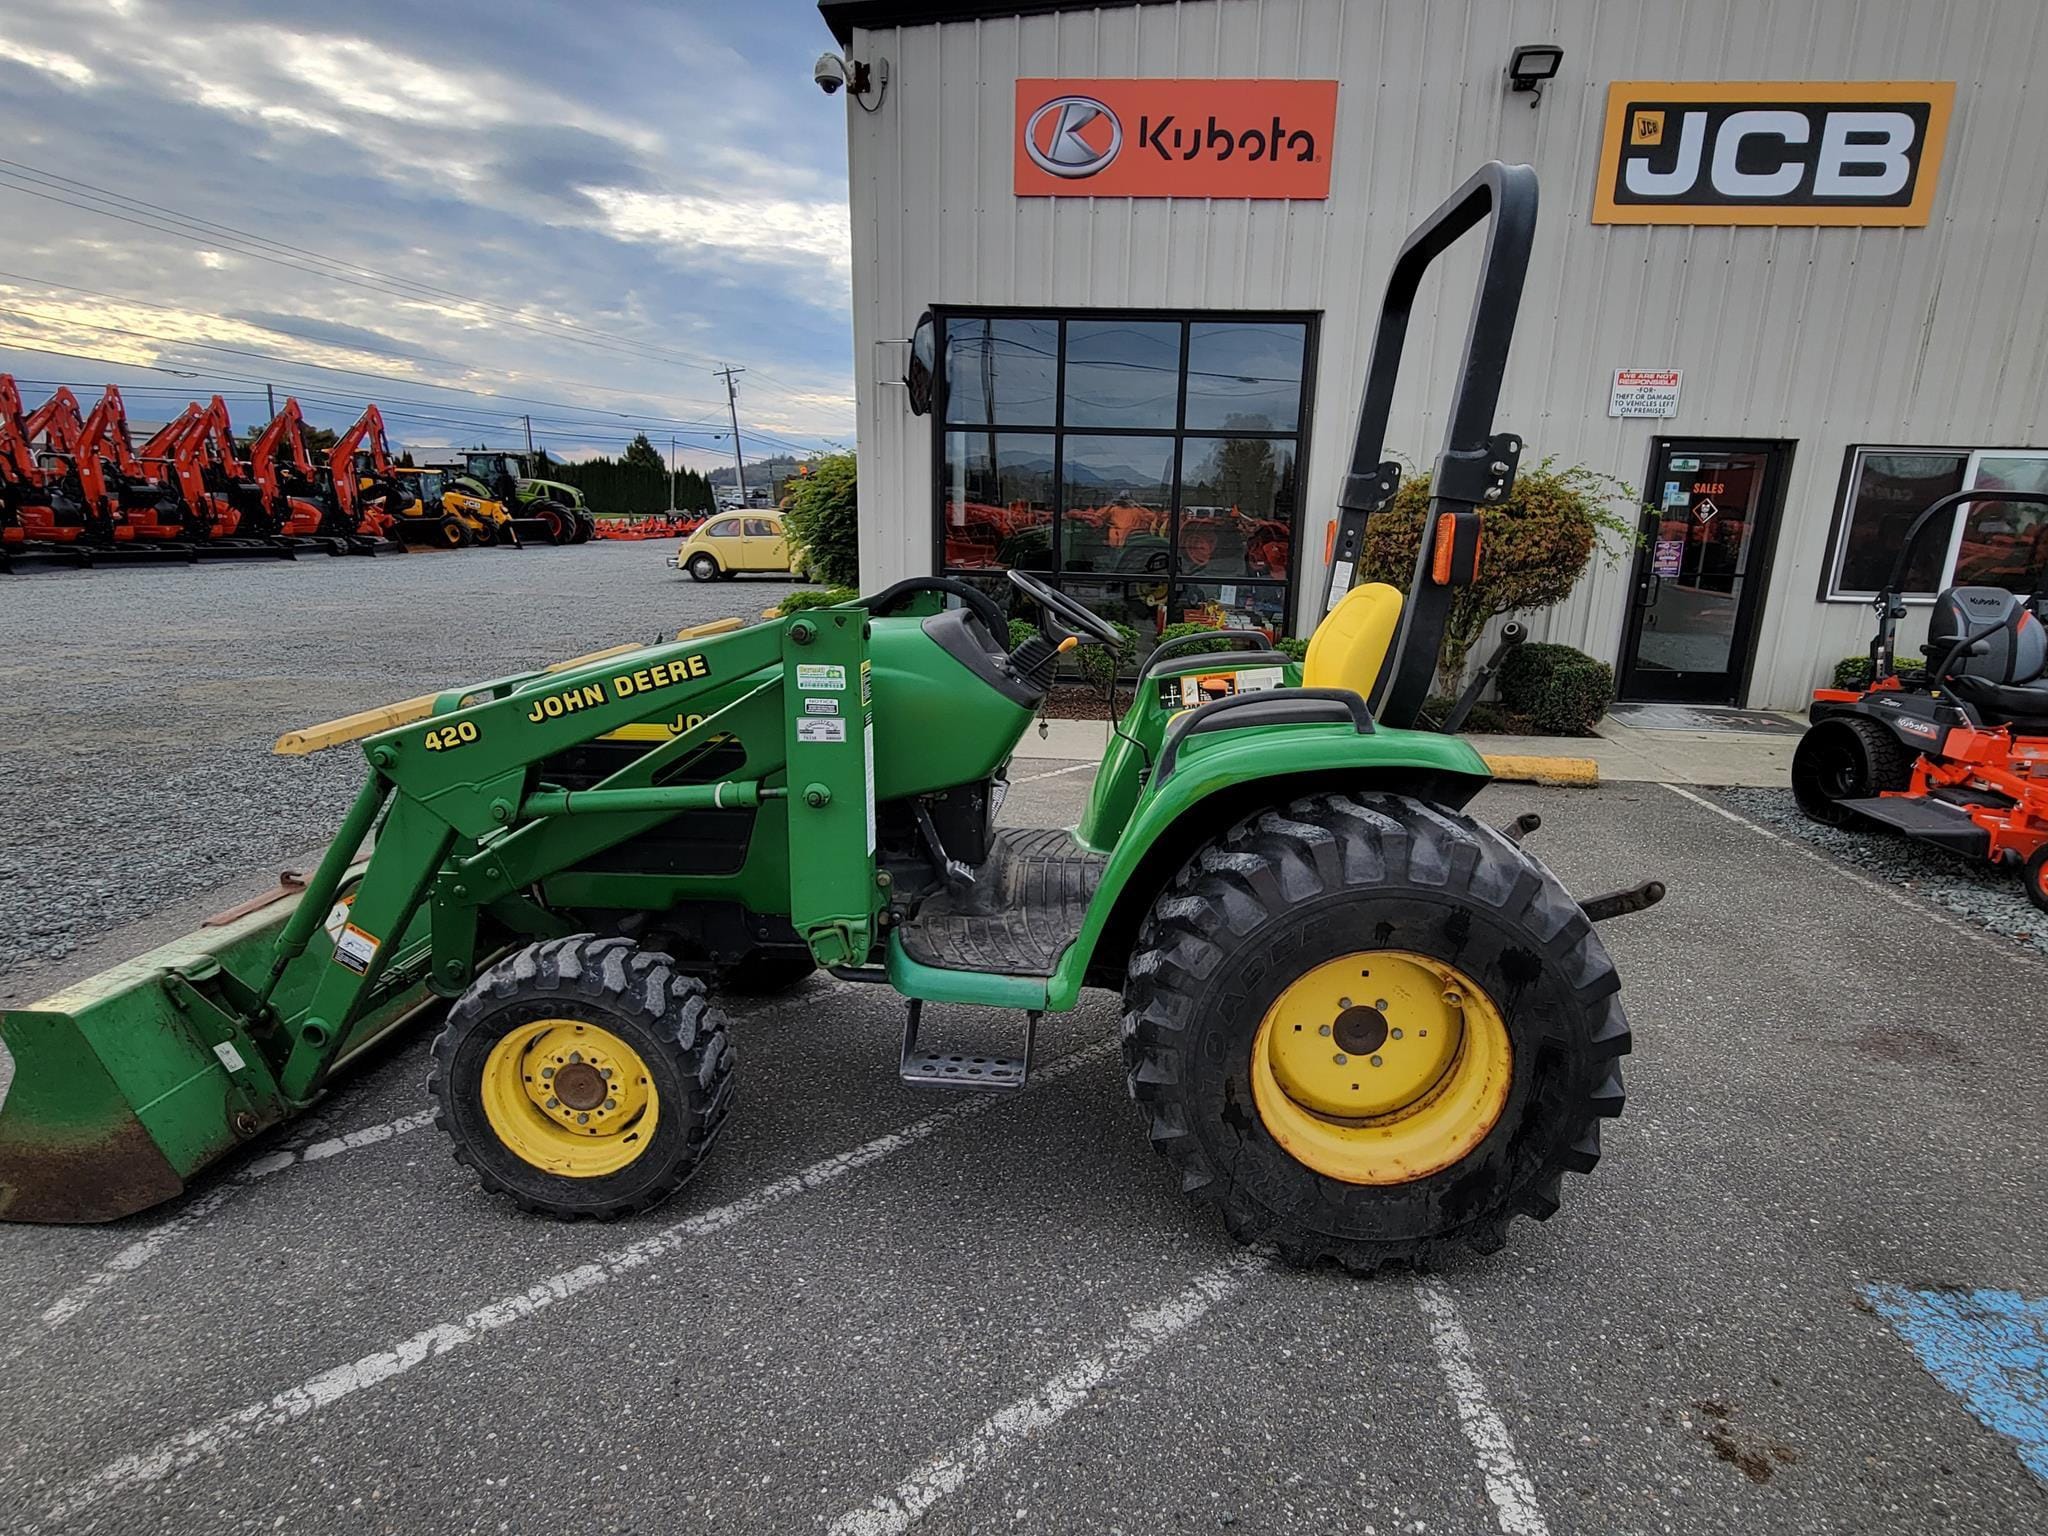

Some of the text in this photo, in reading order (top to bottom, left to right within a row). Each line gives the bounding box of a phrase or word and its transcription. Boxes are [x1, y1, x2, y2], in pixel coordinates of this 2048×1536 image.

[1139, 115, 1316, 162] Kubota
[1640, 119, 1658, 137] JCB
[1625, 110, 1916, 196] JCB
[1693, 482, 1725, 494] SALES
[527, 654, 708, 724] JOHN DEERE
[423, 720, 479, 752] 420
[1897, 718, 1929, 733] Kubota
